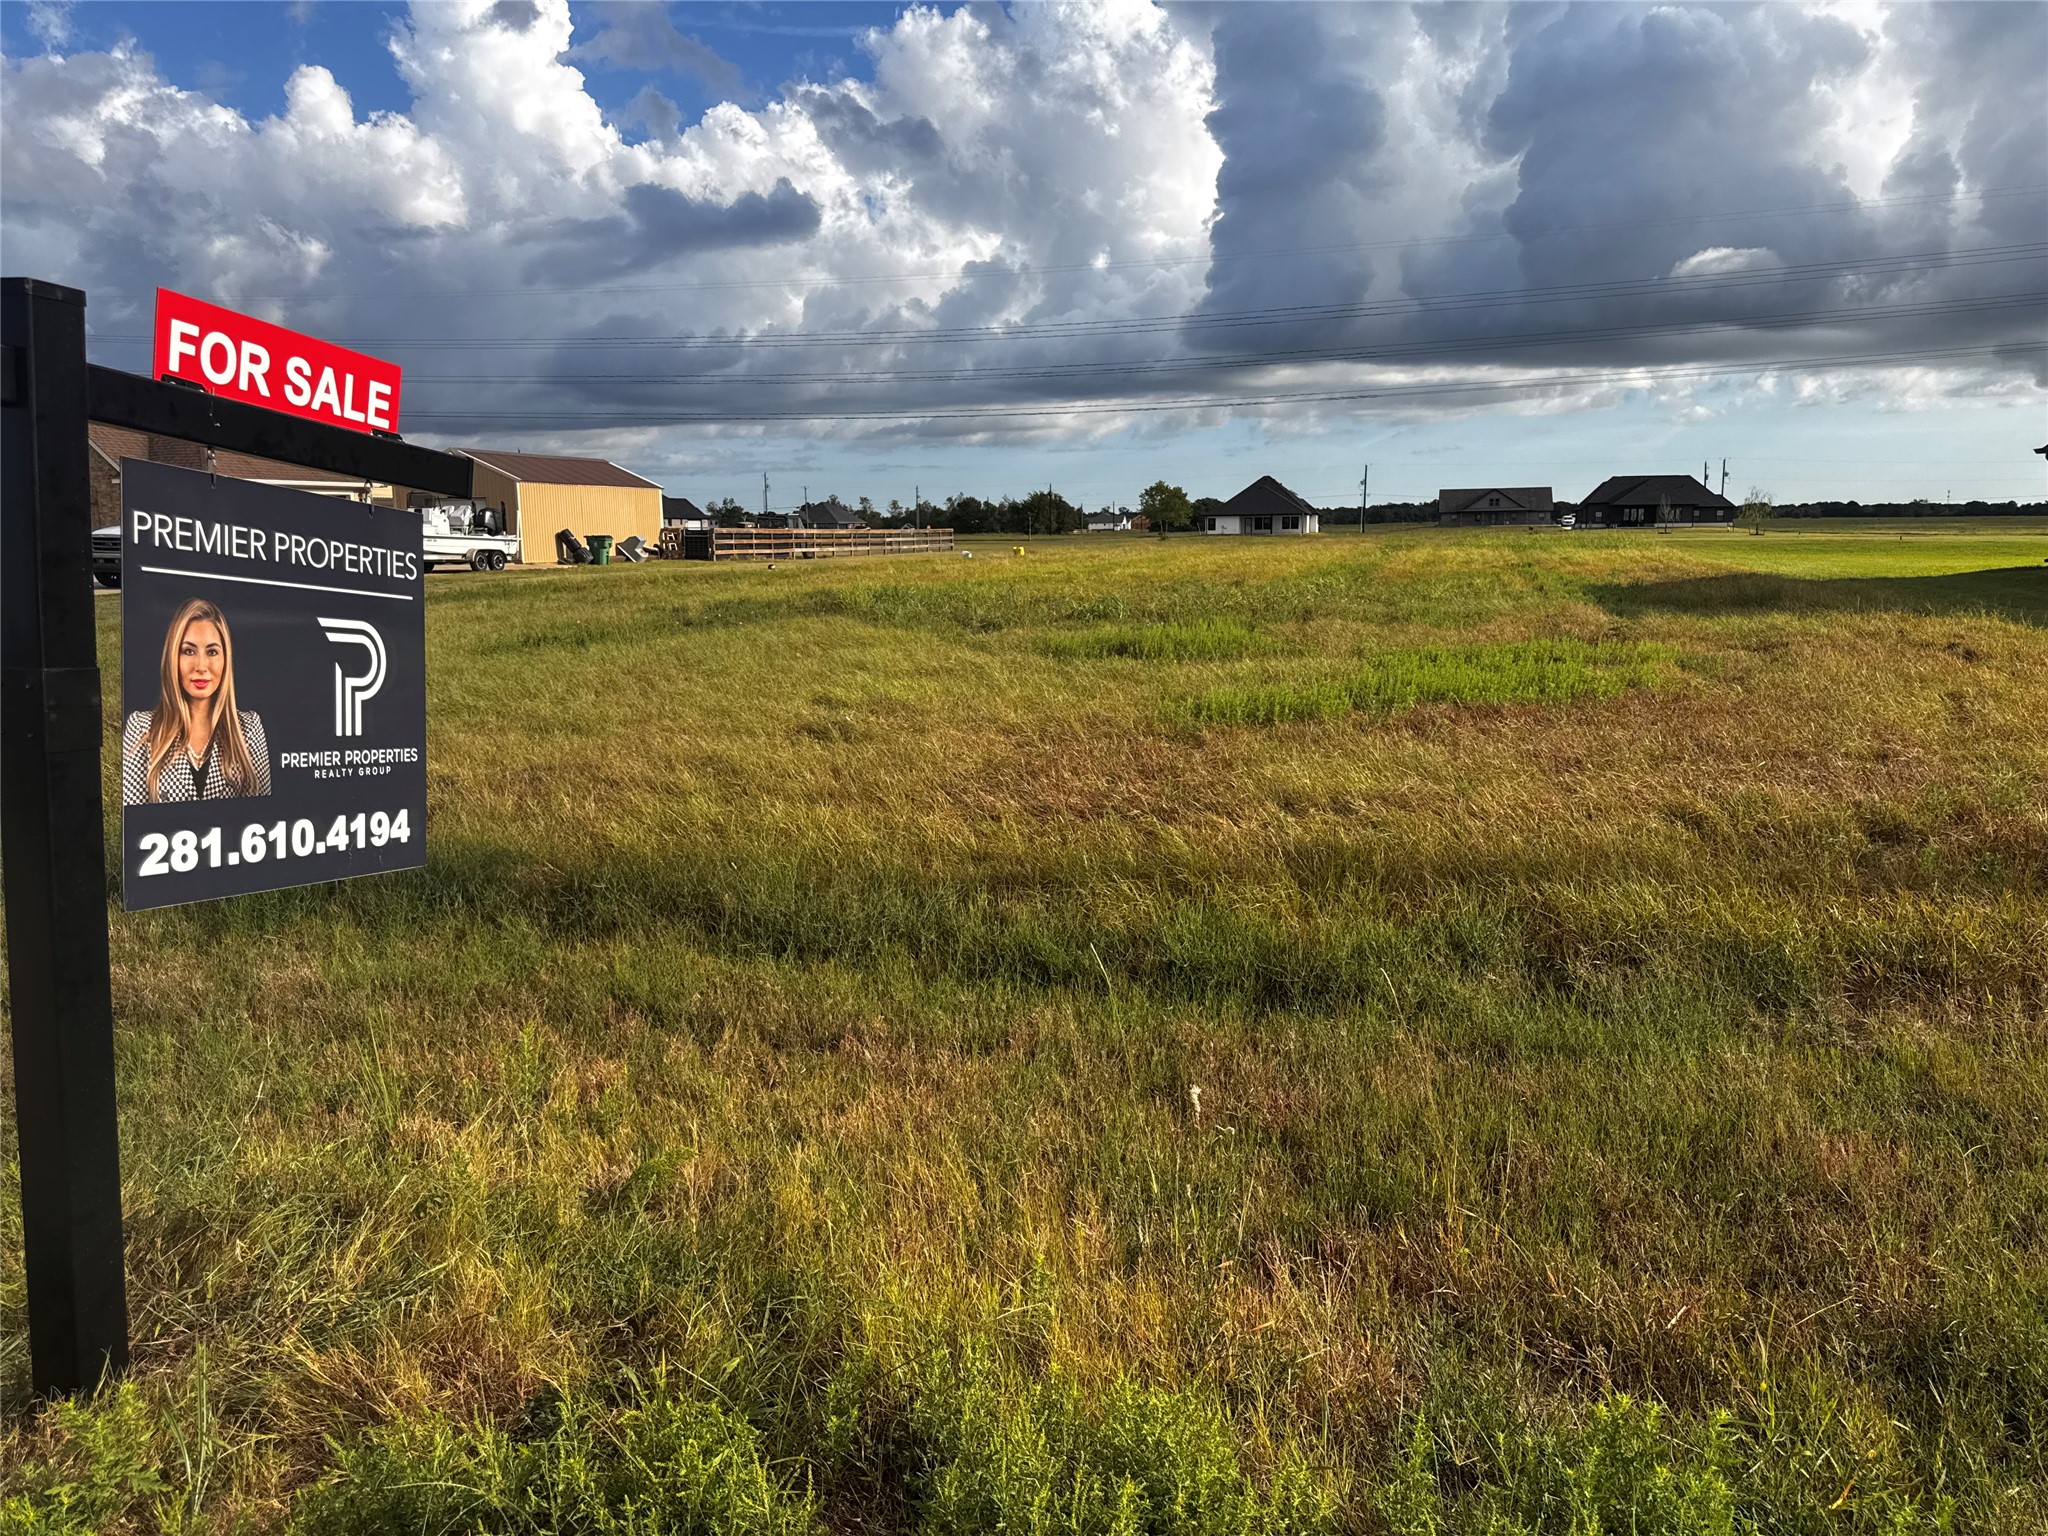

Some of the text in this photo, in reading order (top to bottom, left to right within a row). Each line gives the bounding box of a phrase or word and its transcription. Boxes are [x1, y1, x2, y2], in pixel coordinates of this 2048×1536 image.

[168, 318, 392, 429] FOR SALE
[132, 510, 418, 581] PREMIER PROPERTIES
[281, 748, 418, 769] PREMIER PROPERTIES
[314, 766, 392, 779] REALTY GROUP
[138, 808, 411, 877] 281.610.4194
